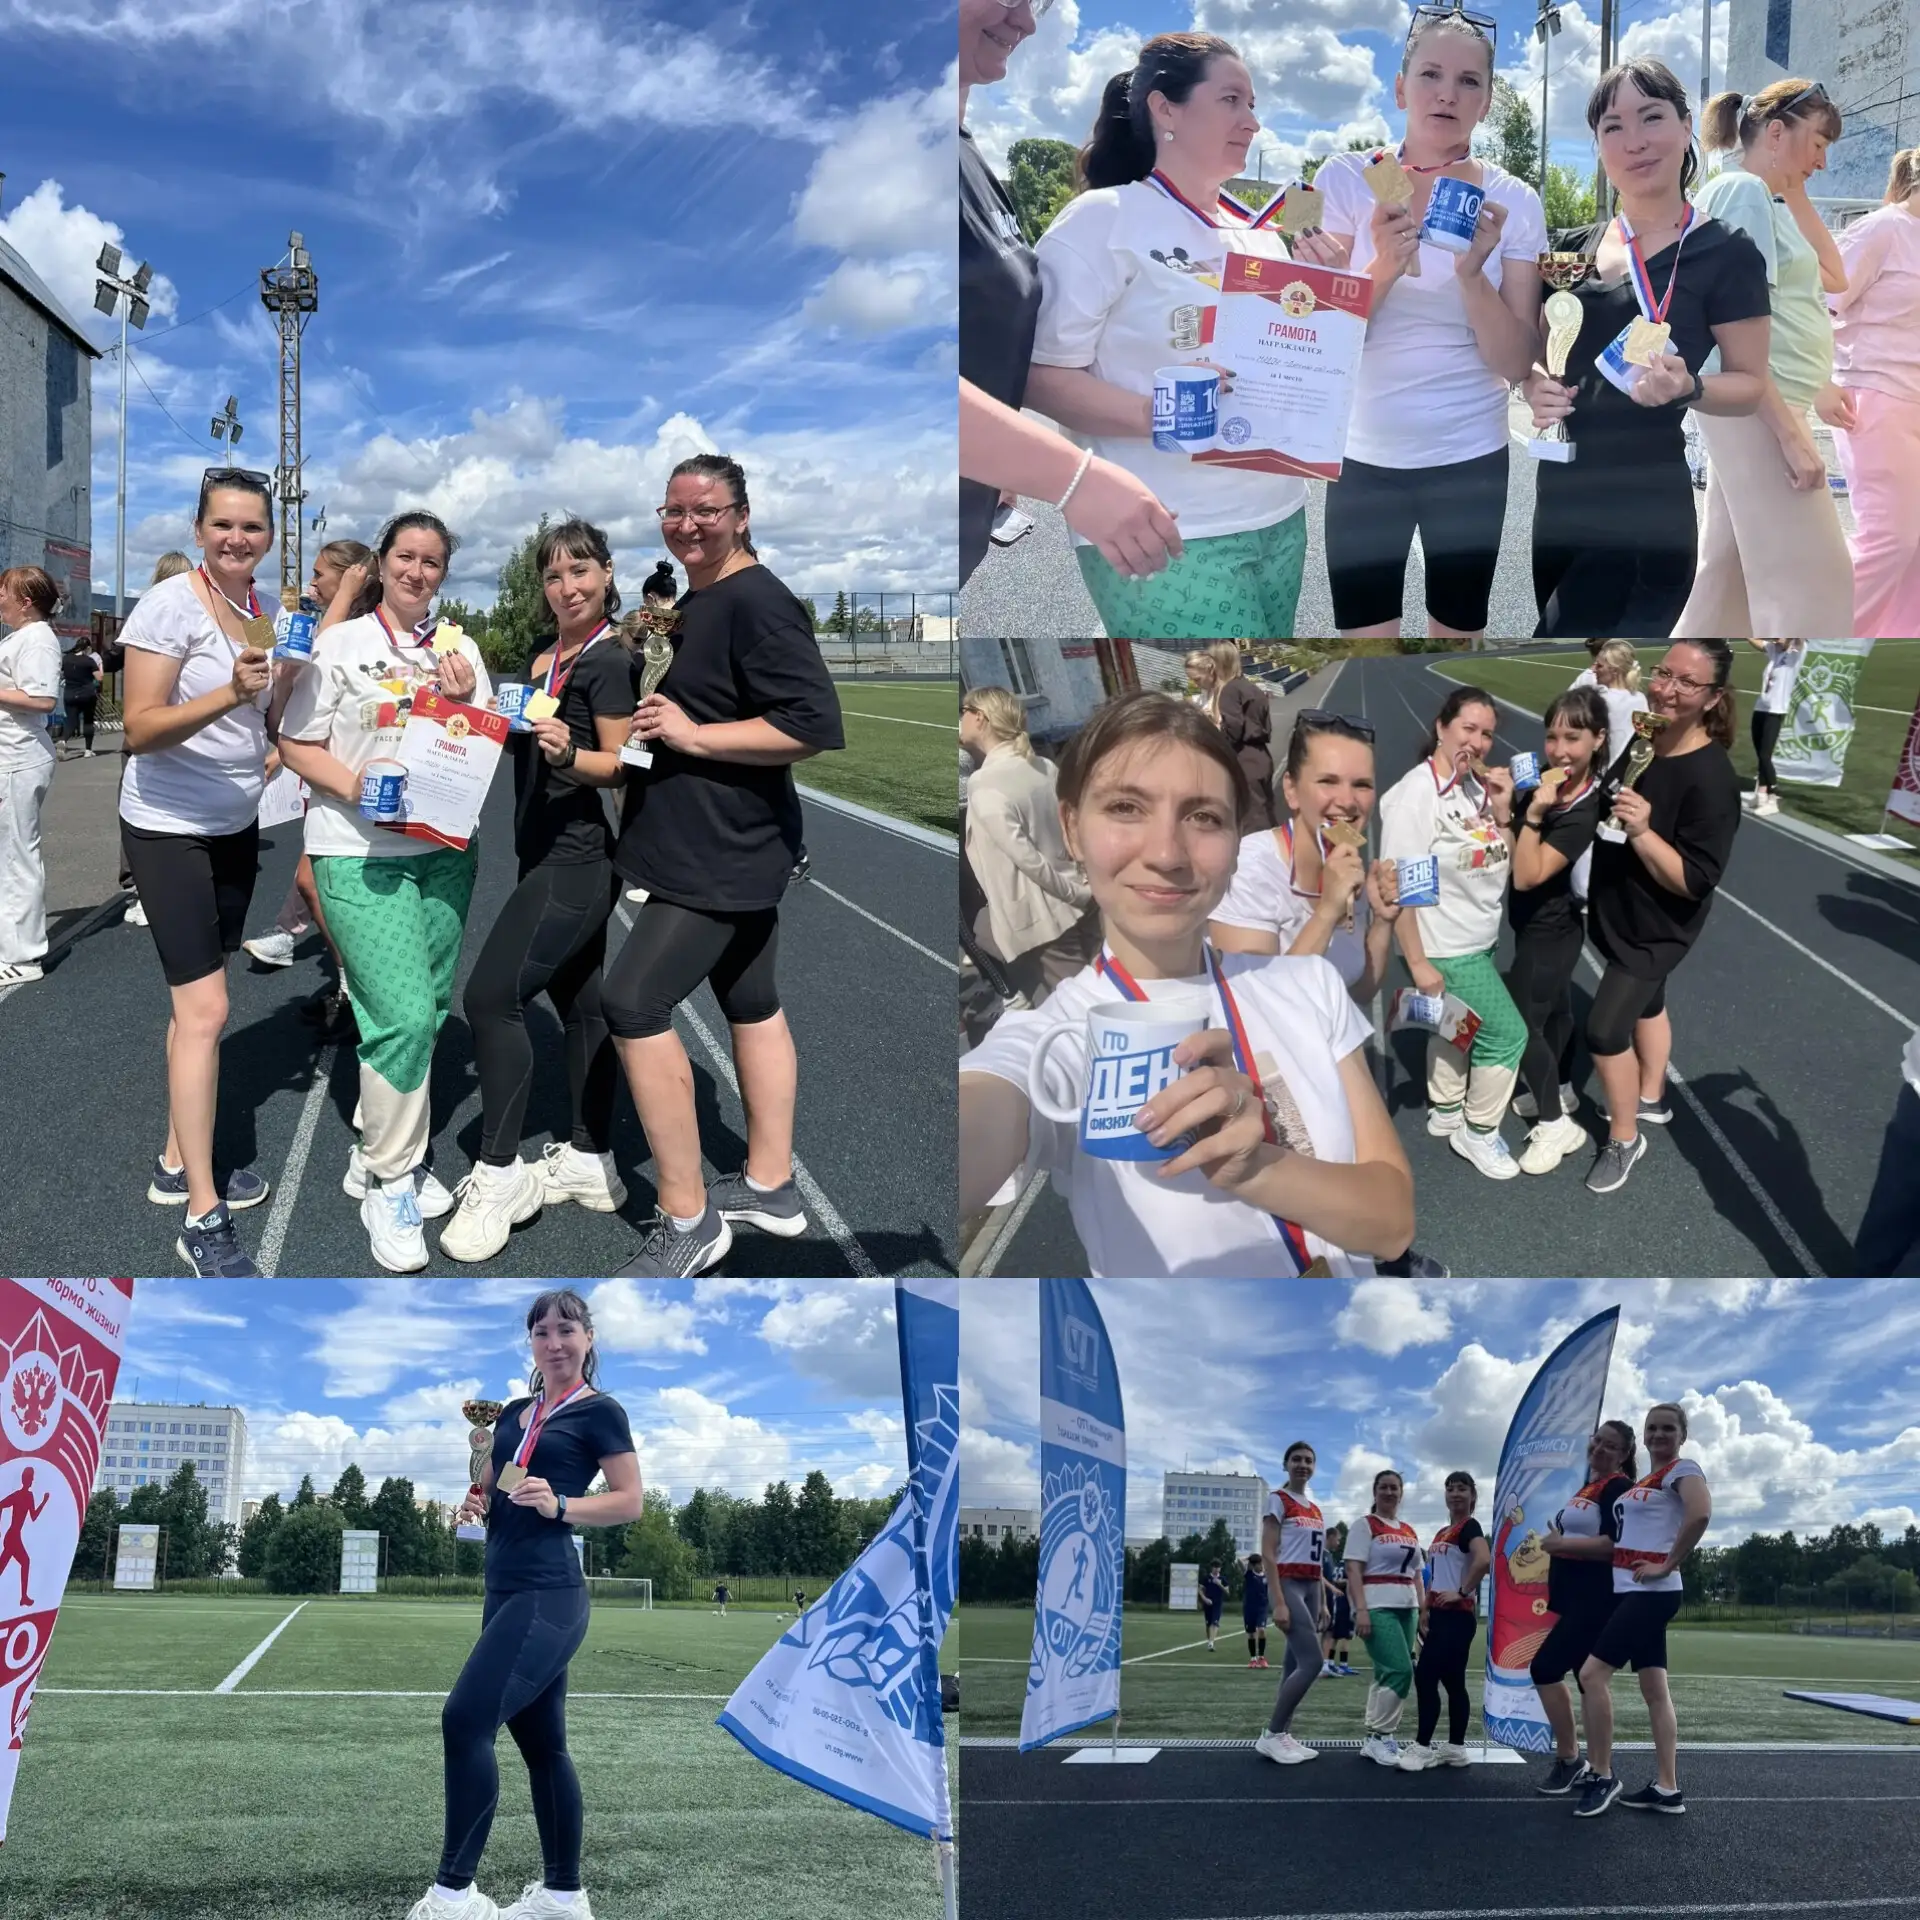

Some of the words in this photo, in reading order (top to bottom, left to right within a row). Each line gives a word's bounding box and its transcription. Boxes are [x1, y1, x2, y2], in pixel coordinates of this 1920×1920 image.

[1457, 190, 1480, 218] 10
[1331, 276, 1360, 299] ГТО
[1268, 322, 1317, 343] ГРАМОТА
[481, 713, 501, 730] ГТО
[434, 738, 467, 757] ГРАМОТА
[1807, 733, 1838, 748] ГТО
[1102, 1030, 1129, 1052] ГТО
[1088, 1049, 1182, 1108] ДЕН
[1089, 1113, 1137, 1131] ФИЗКУЛ
[46, 1278, 85, 1309] норма
[85, 1303, 121, 1339] жизни!
[1310, 1530, 1323, 1562] 5
[1400, 1545, 1415, 1573] 7
